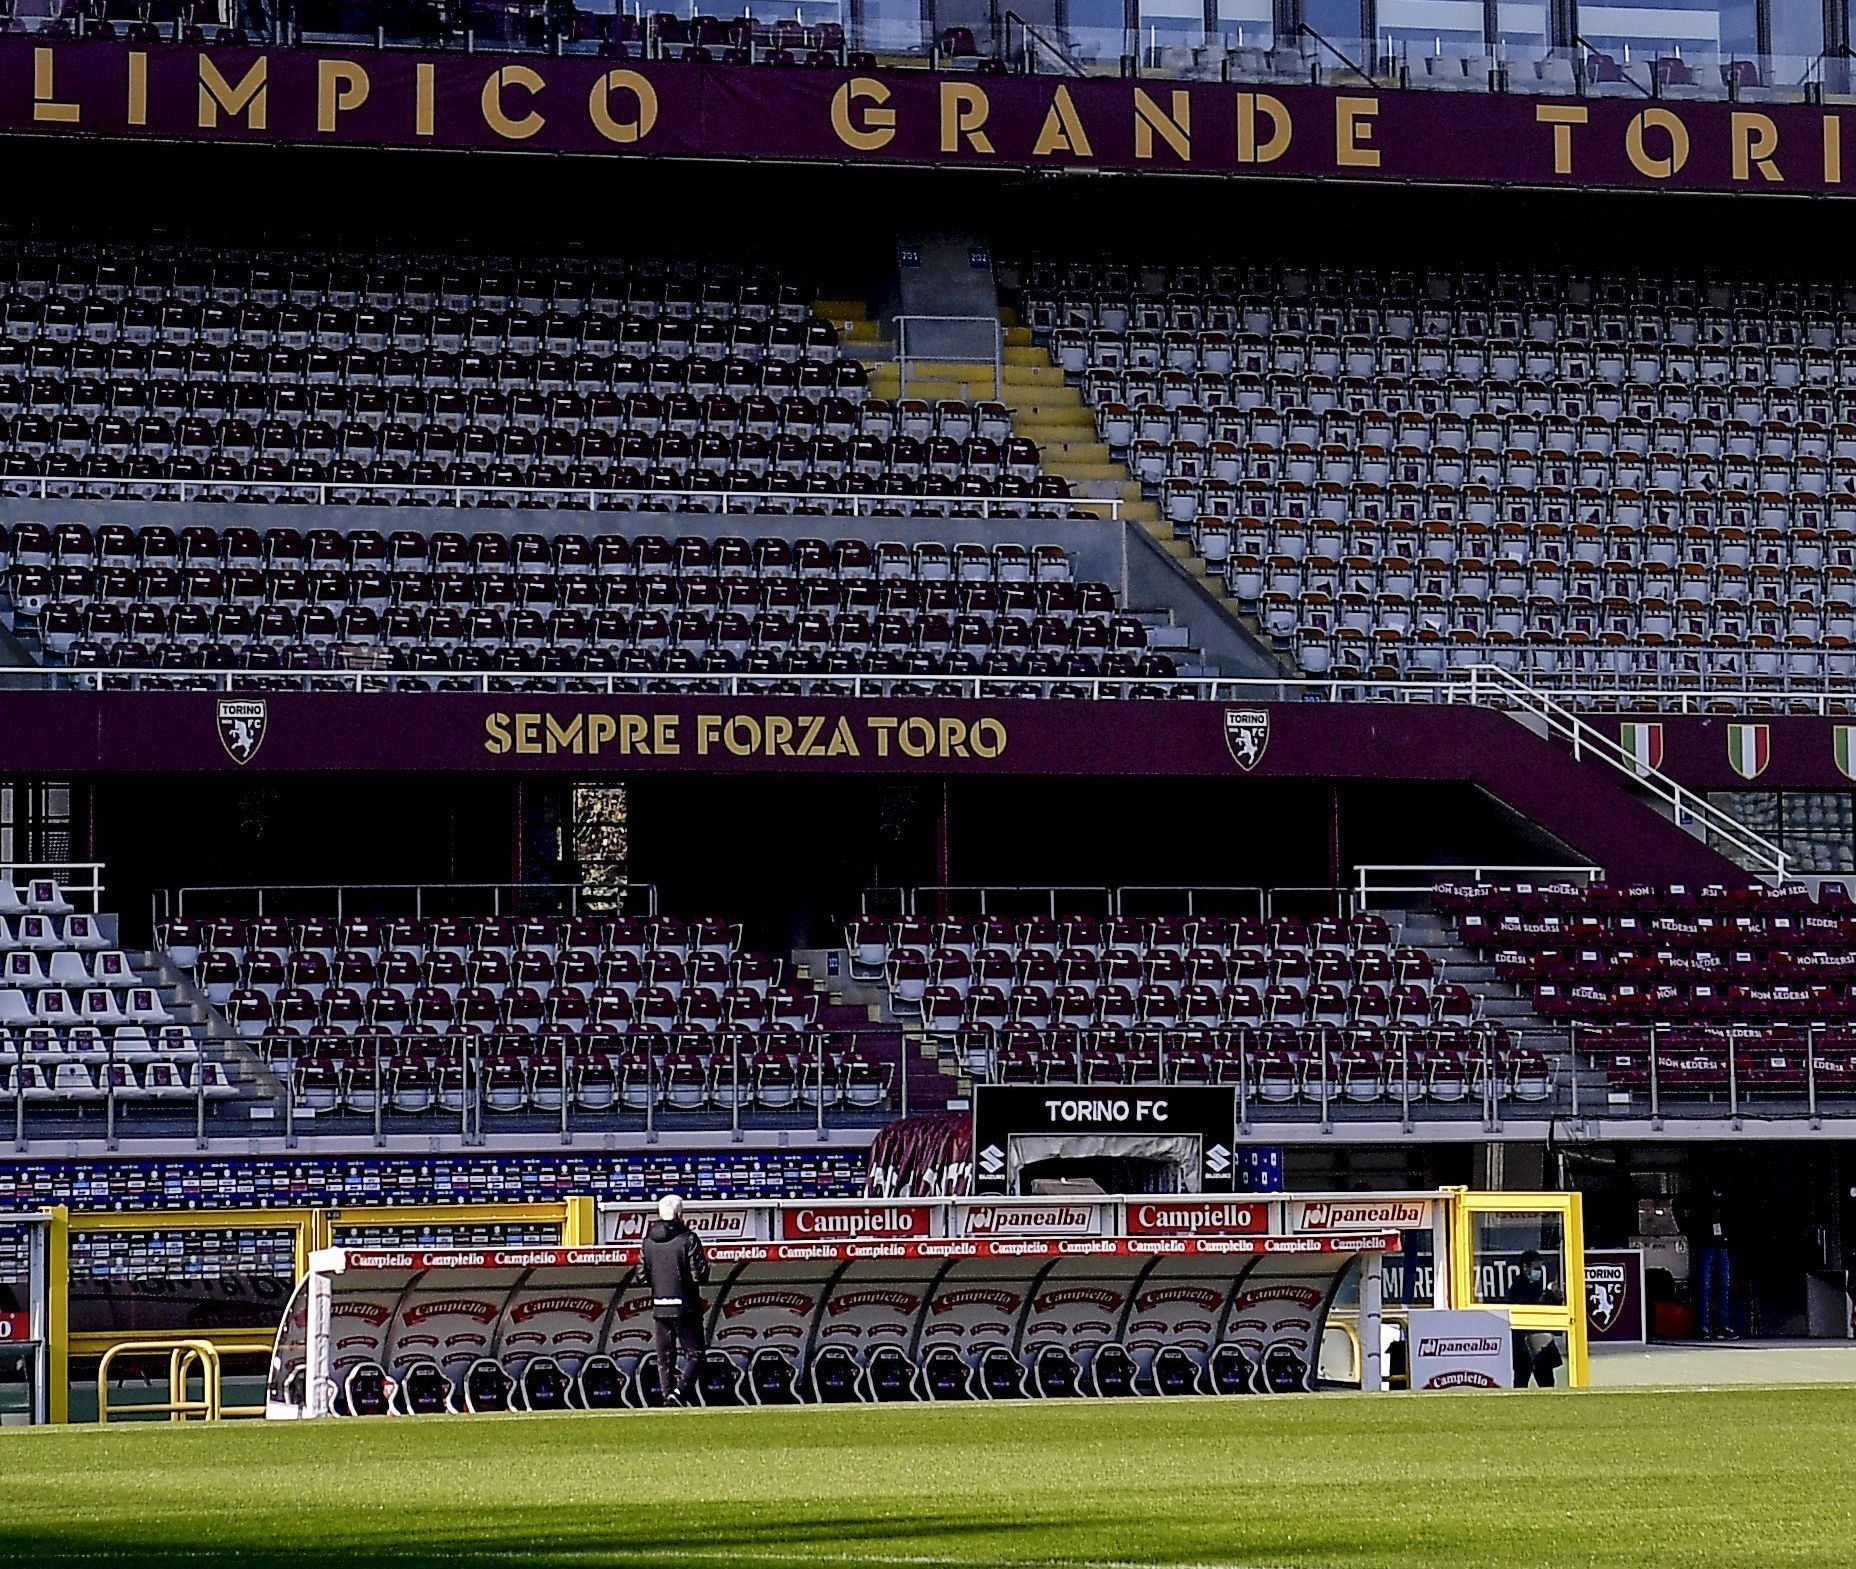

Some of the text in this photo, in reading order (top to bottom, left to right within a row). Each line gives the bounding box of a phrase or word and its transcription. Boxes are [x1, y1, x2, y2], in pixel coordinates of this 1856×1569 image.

[830, 76, 1382, 168] GRANDE
[222, 705, 261, 715] TORINO
[247, 718, 262, 729] FC
[1229, 714, 1265, 724] TORINO
[484, 710, 1009, 760] SEMPRE FORZA TORO
[1252, 727, 1264, 737] FC
[1046, 1099, 1169, 1123] TORINO FC
[796, 1207, 913, 1235] Campiello
[996, 1205, 1087, 1230] panealba
[1138, 1203, 1252, 1232] Campiello
[1332, 1202, 1419, 1224] panealba
[846, 1243, 906, 1259] Campiello
[917, 1242, 976, 1258] Campiello
[989, 1240, 1047, 1255] Campiello
[1058, 1239, 1116, 1254] Campiello
[1128, 1238, 1185, 1253] Campiello
[1196, 1238, 1254, 1253] Campiello
[1264, 1238, 1322, 1253] Campiello
[1330, 1235, 1386, 1251] Campiello
[351, 1253, 412, 1268] Campiello
[423, 1252, 484, 1267] Campiello
[495, 1250, 556, 1266] Campiello
[567, 1250, 627, 1265] Campiello
[707, 1246, 767, 1261] Campiello
[778, 1245, 837, 1260] Campiello
[943, 1288, 1012, 1305] Campiello
[1045, 1288, 1114, 1304] Campiello
[1146, 1287, 1214, 1304] Campiello
[1246, 1285, 1313, 1302] Campiello
[1607, 1283, 1621, 1294] FC
[524, 1297, 595, 1313] Campiello
[734, 1291, 805, 1308] Campiello
[840, 1290, 910, 1306] Campiello
[415, 1299, 487, 1317] Campiello
[1438, 1340, 1498, 1356] panealba
[1433, 1373, 1489, 1389] Campiello
